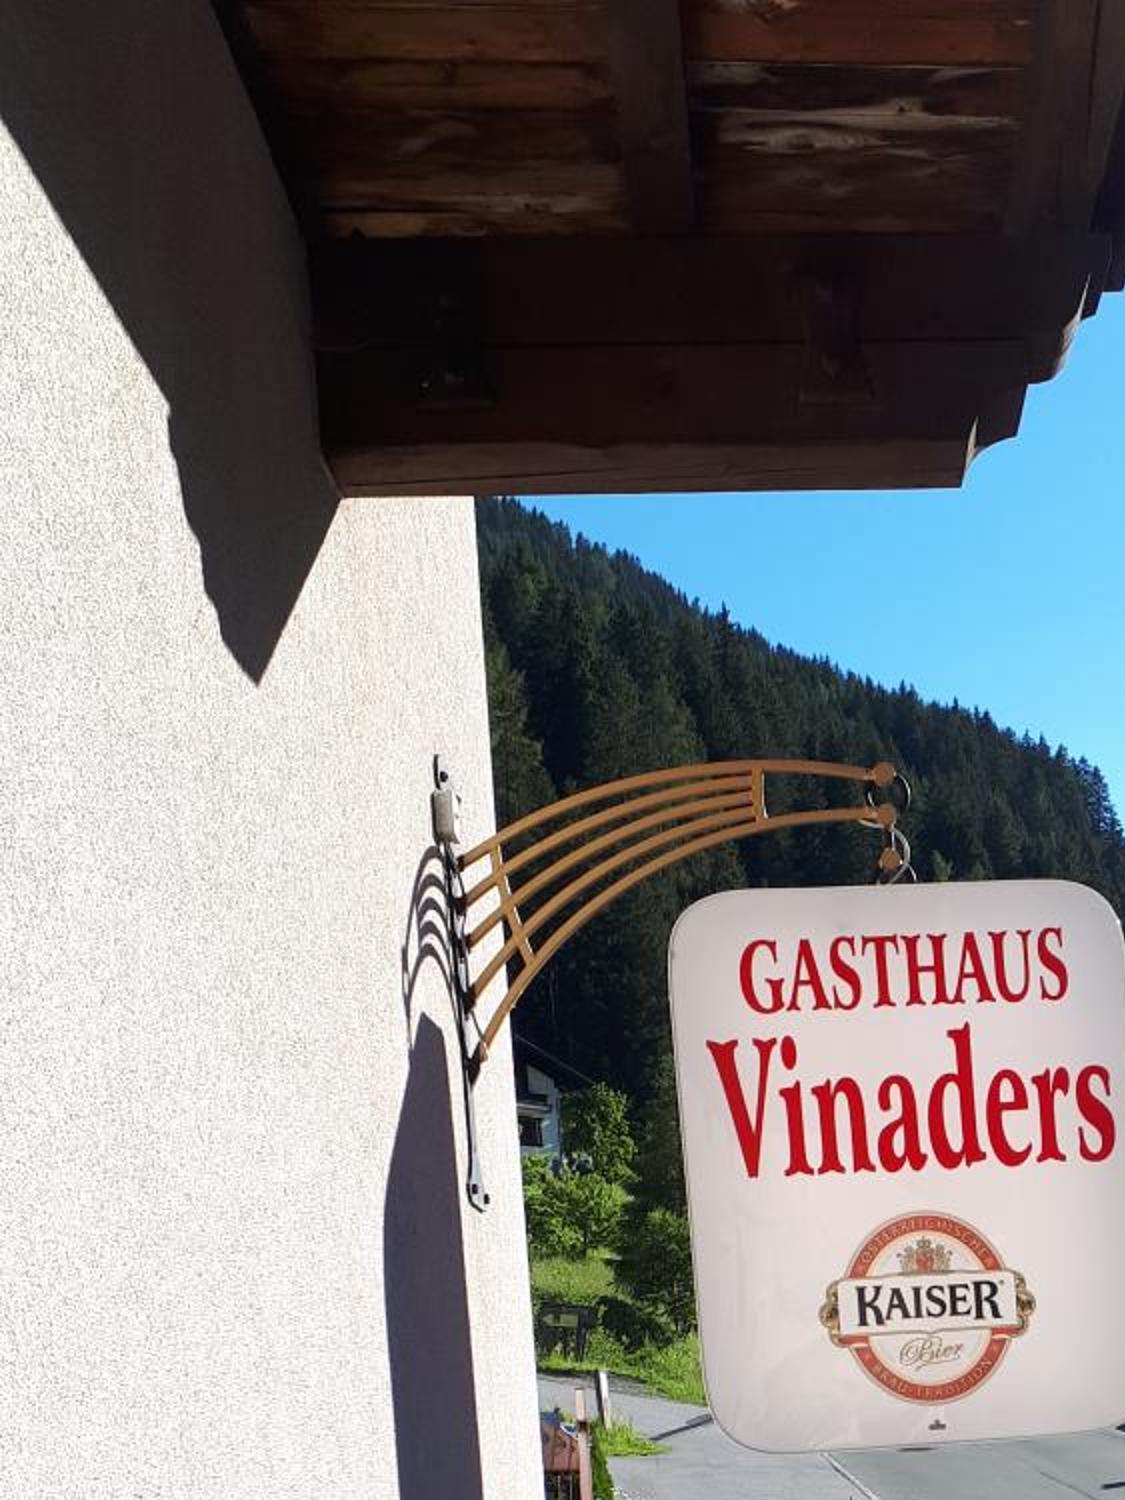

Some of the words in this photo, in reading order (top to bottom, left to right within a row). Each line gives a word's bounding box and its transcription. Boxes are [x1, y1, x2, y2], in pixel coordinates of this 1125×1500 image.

[739, 927, 1069, 1014] GASTHAUS
[706, 1021, 1117, 1178] Vinaders
[856, 1280, 1002, 1327] KAISER
[900, 1335, 964, 1371] Bier
